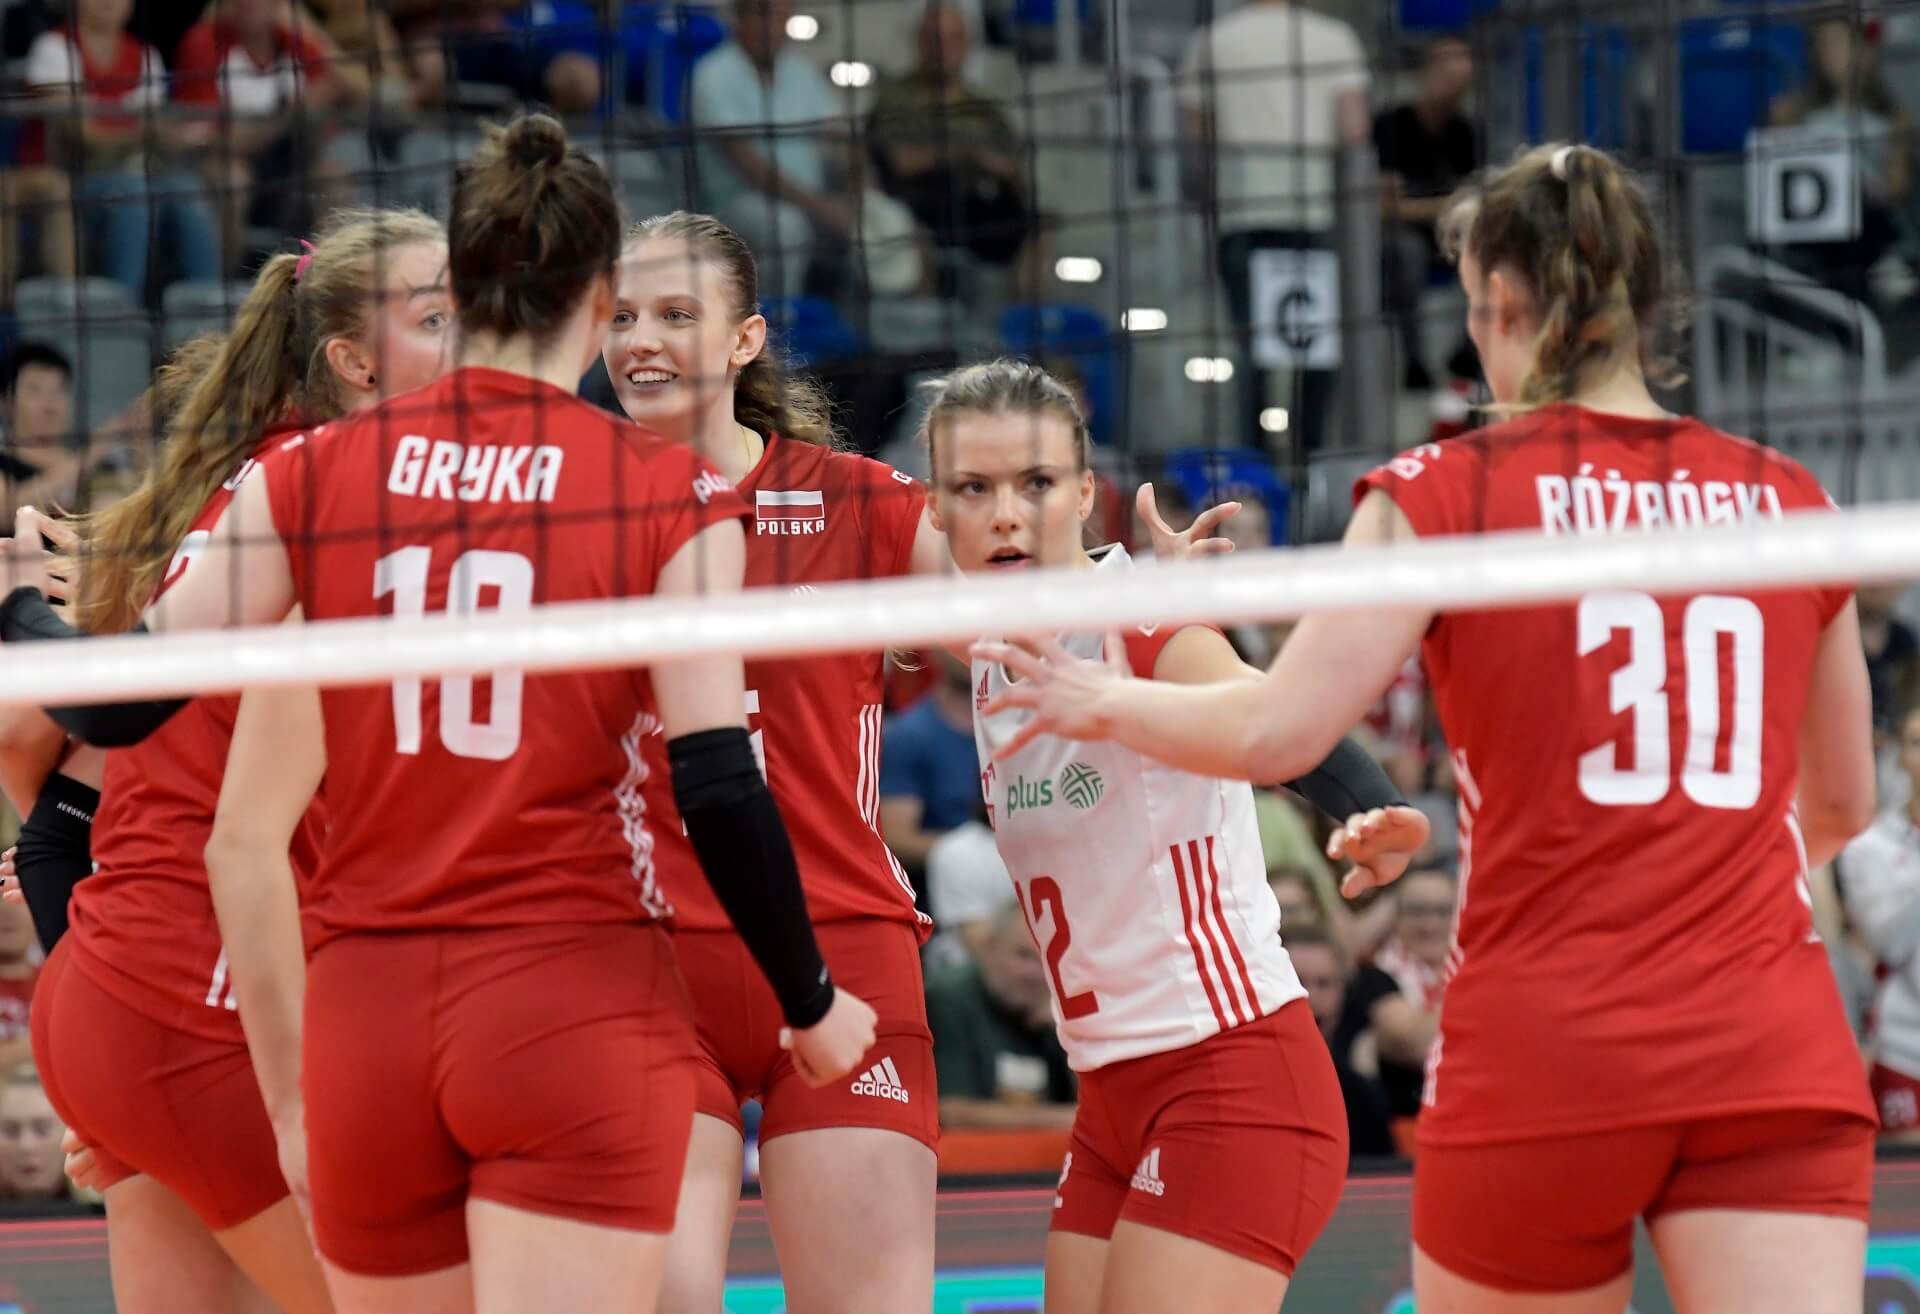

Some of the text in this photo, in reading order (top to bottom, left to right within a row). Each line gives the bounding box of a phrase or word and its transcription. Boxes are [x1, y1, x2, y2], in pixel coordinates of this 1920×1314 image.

[1780, 167, 1828, 222] D
[1277, 288, 1313, 351] C
[387, 435, 564, 503] GRYKA
[756, 519, 825, 536] POLSKA
[1577, 589, 1765, 810] 30
[1007, 774, 1054, 819] plus
[851, 1080, 909, 1104] adidas
